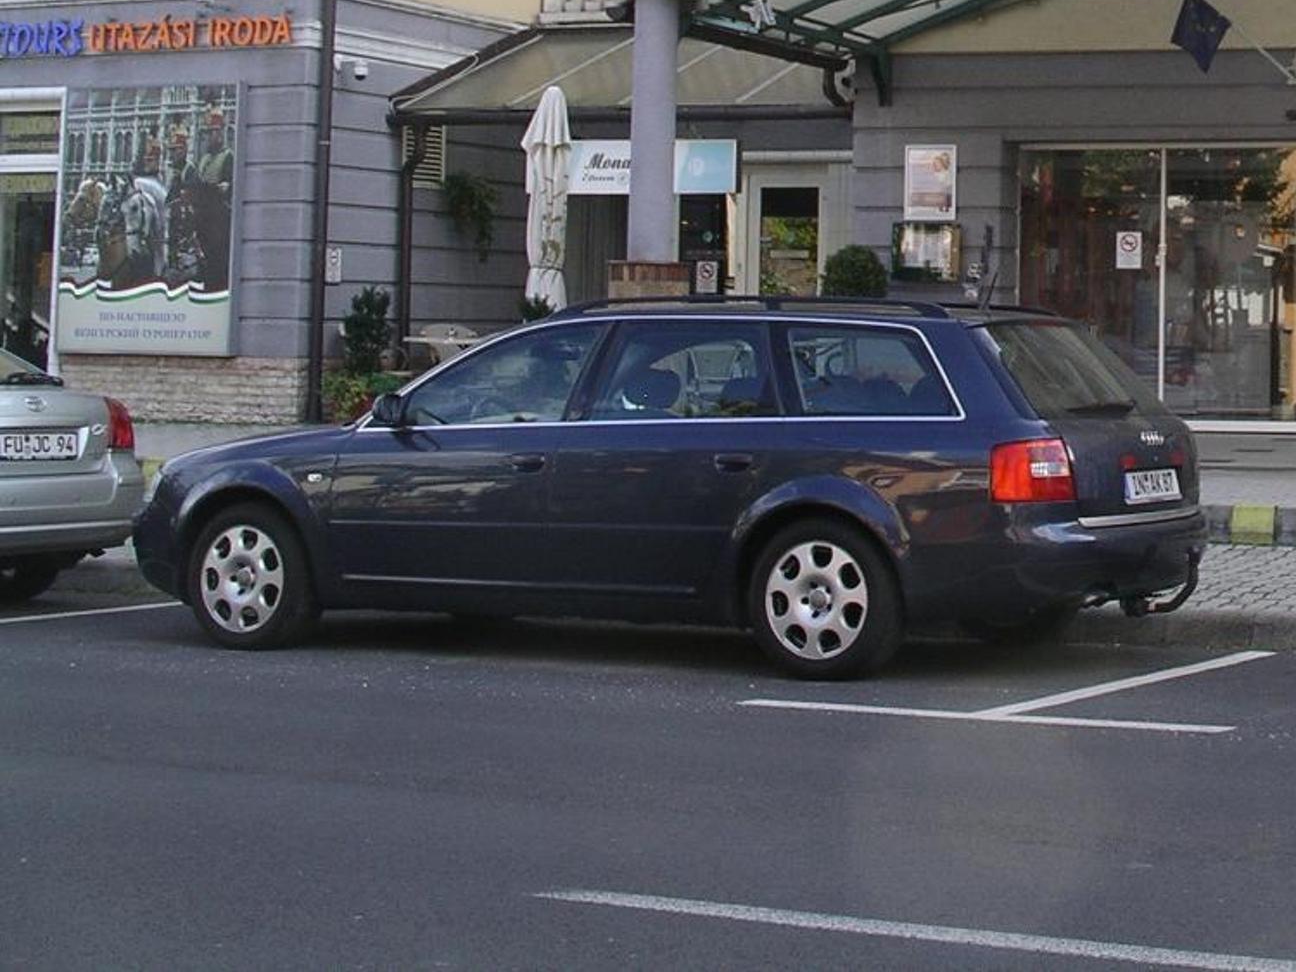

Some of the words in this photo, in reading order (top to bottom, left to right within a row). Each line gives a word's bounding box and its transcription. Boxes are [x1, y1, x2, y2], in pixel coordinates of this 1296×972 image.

[0, 17, 84, 58] TOURS
[88, 14, 196, 52] UTAZÁSI
[208, 14, 292, 46] IRODA
[57, 436, 74, 452] 94
